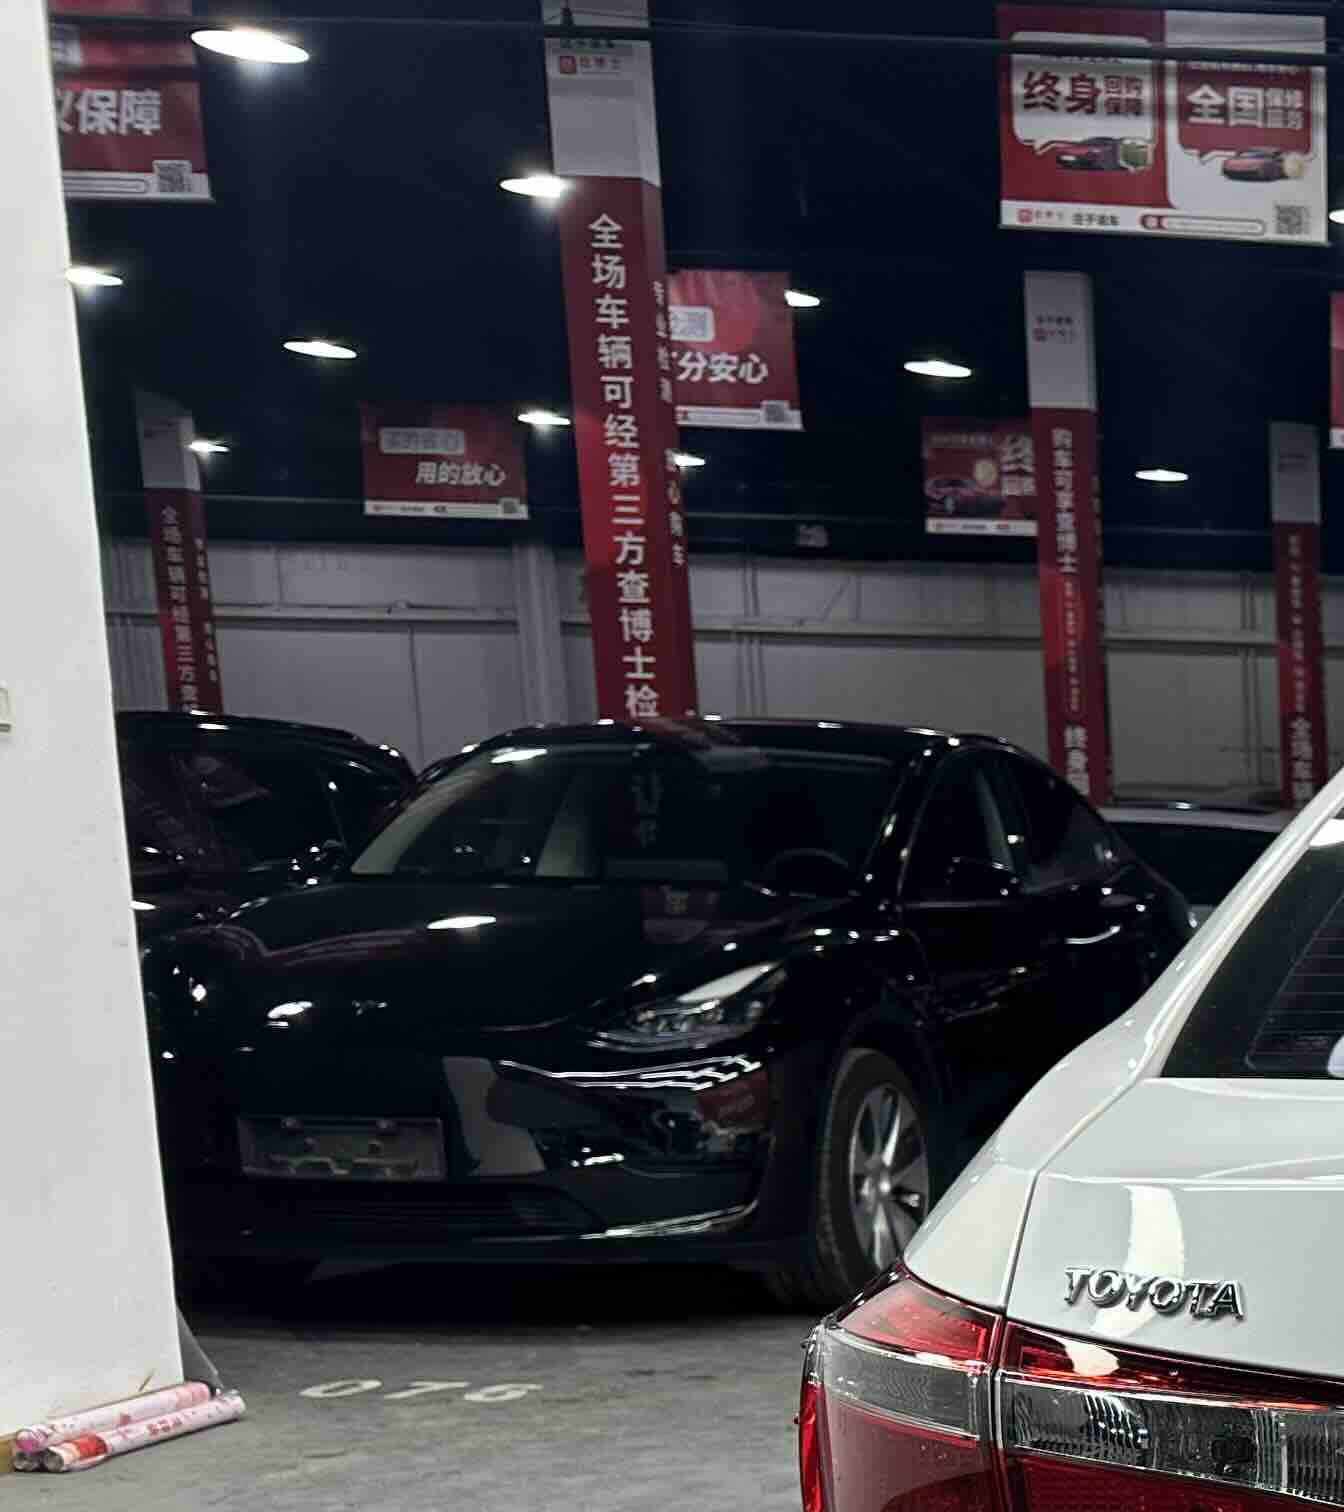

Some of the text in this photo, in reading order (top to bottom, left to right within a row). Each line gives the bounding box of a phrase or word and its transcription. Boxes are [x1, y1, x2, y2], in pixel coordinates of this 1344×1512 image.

[1023, 71, 1102, 116] 终身
[1187, 84, 1264, 127] 全国
[671, 351, 768, 384] 分安心
[415, 461, 507, 487] 用的放心
[588, 213, 660, 719] 全场车辆可经第三方查博士检
[1063, 1265, 1245, 1321] TOYOTA
